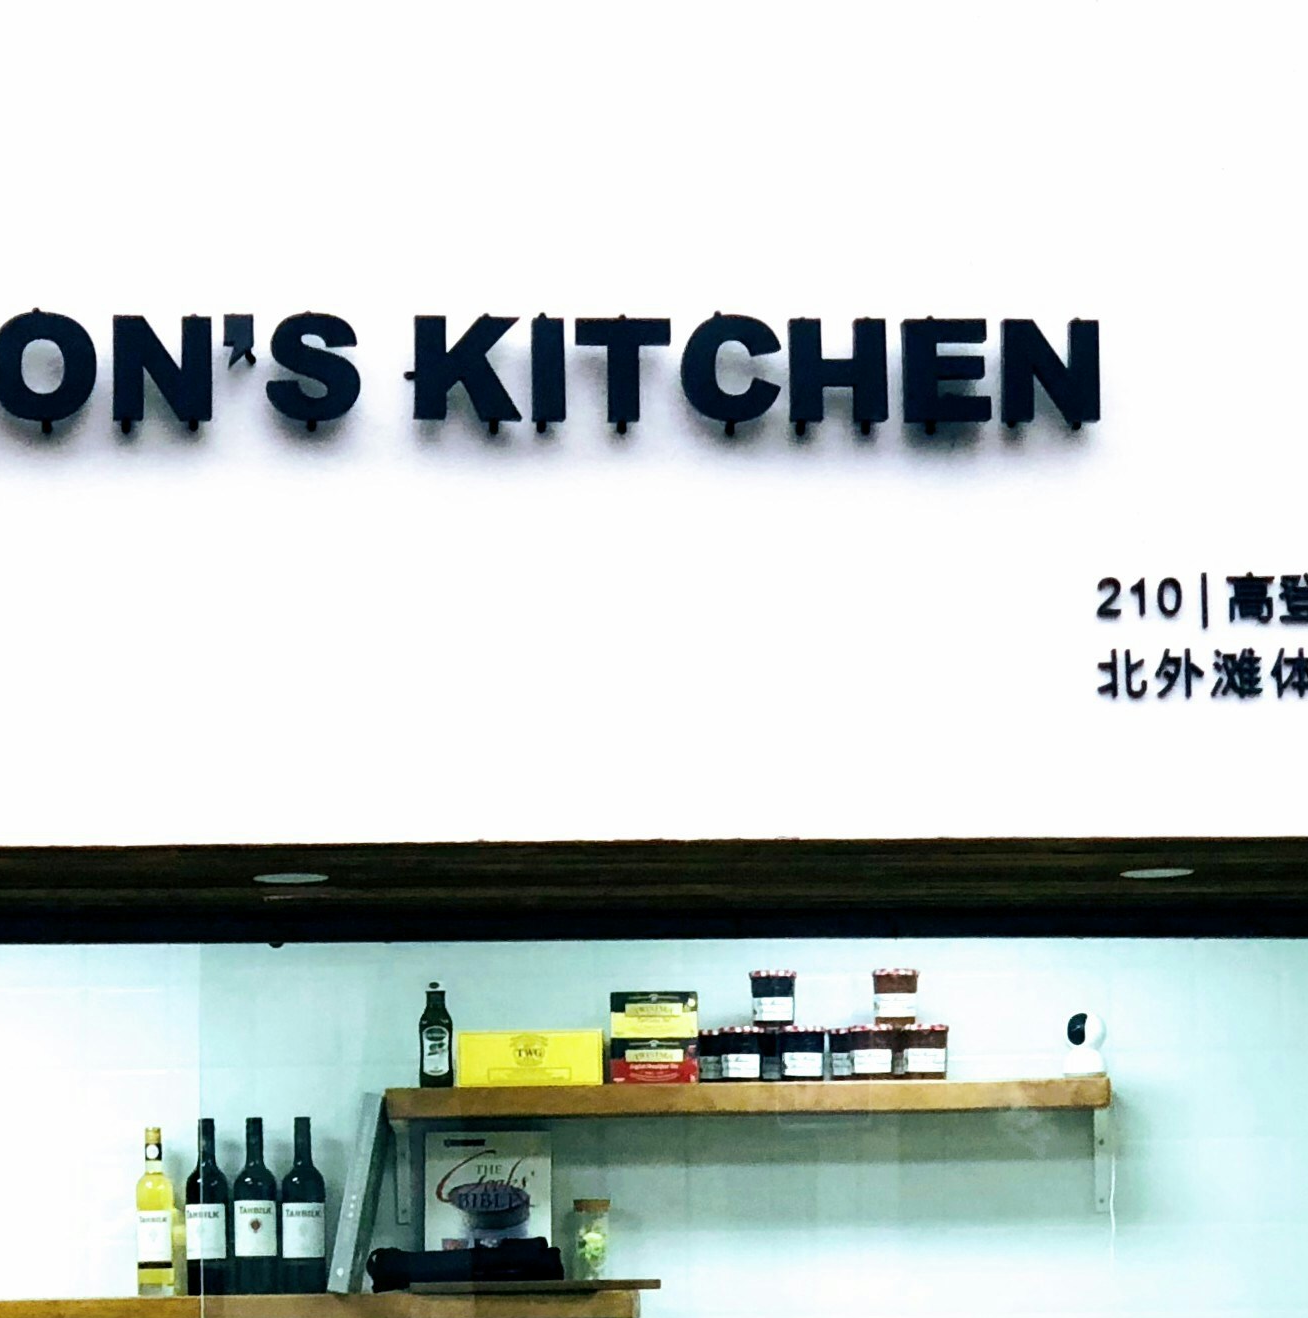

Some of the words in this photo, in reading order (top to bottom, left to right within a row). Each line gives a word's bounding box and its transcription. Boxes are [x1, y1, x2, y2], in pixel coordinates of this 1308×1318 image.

[412, 310, 1101, 424] KITCHEN
[1097, 577, 1182, 618] 210
[517, 1048, 543, 1058] TWG
[476, 1164, 503, 1175] THE
